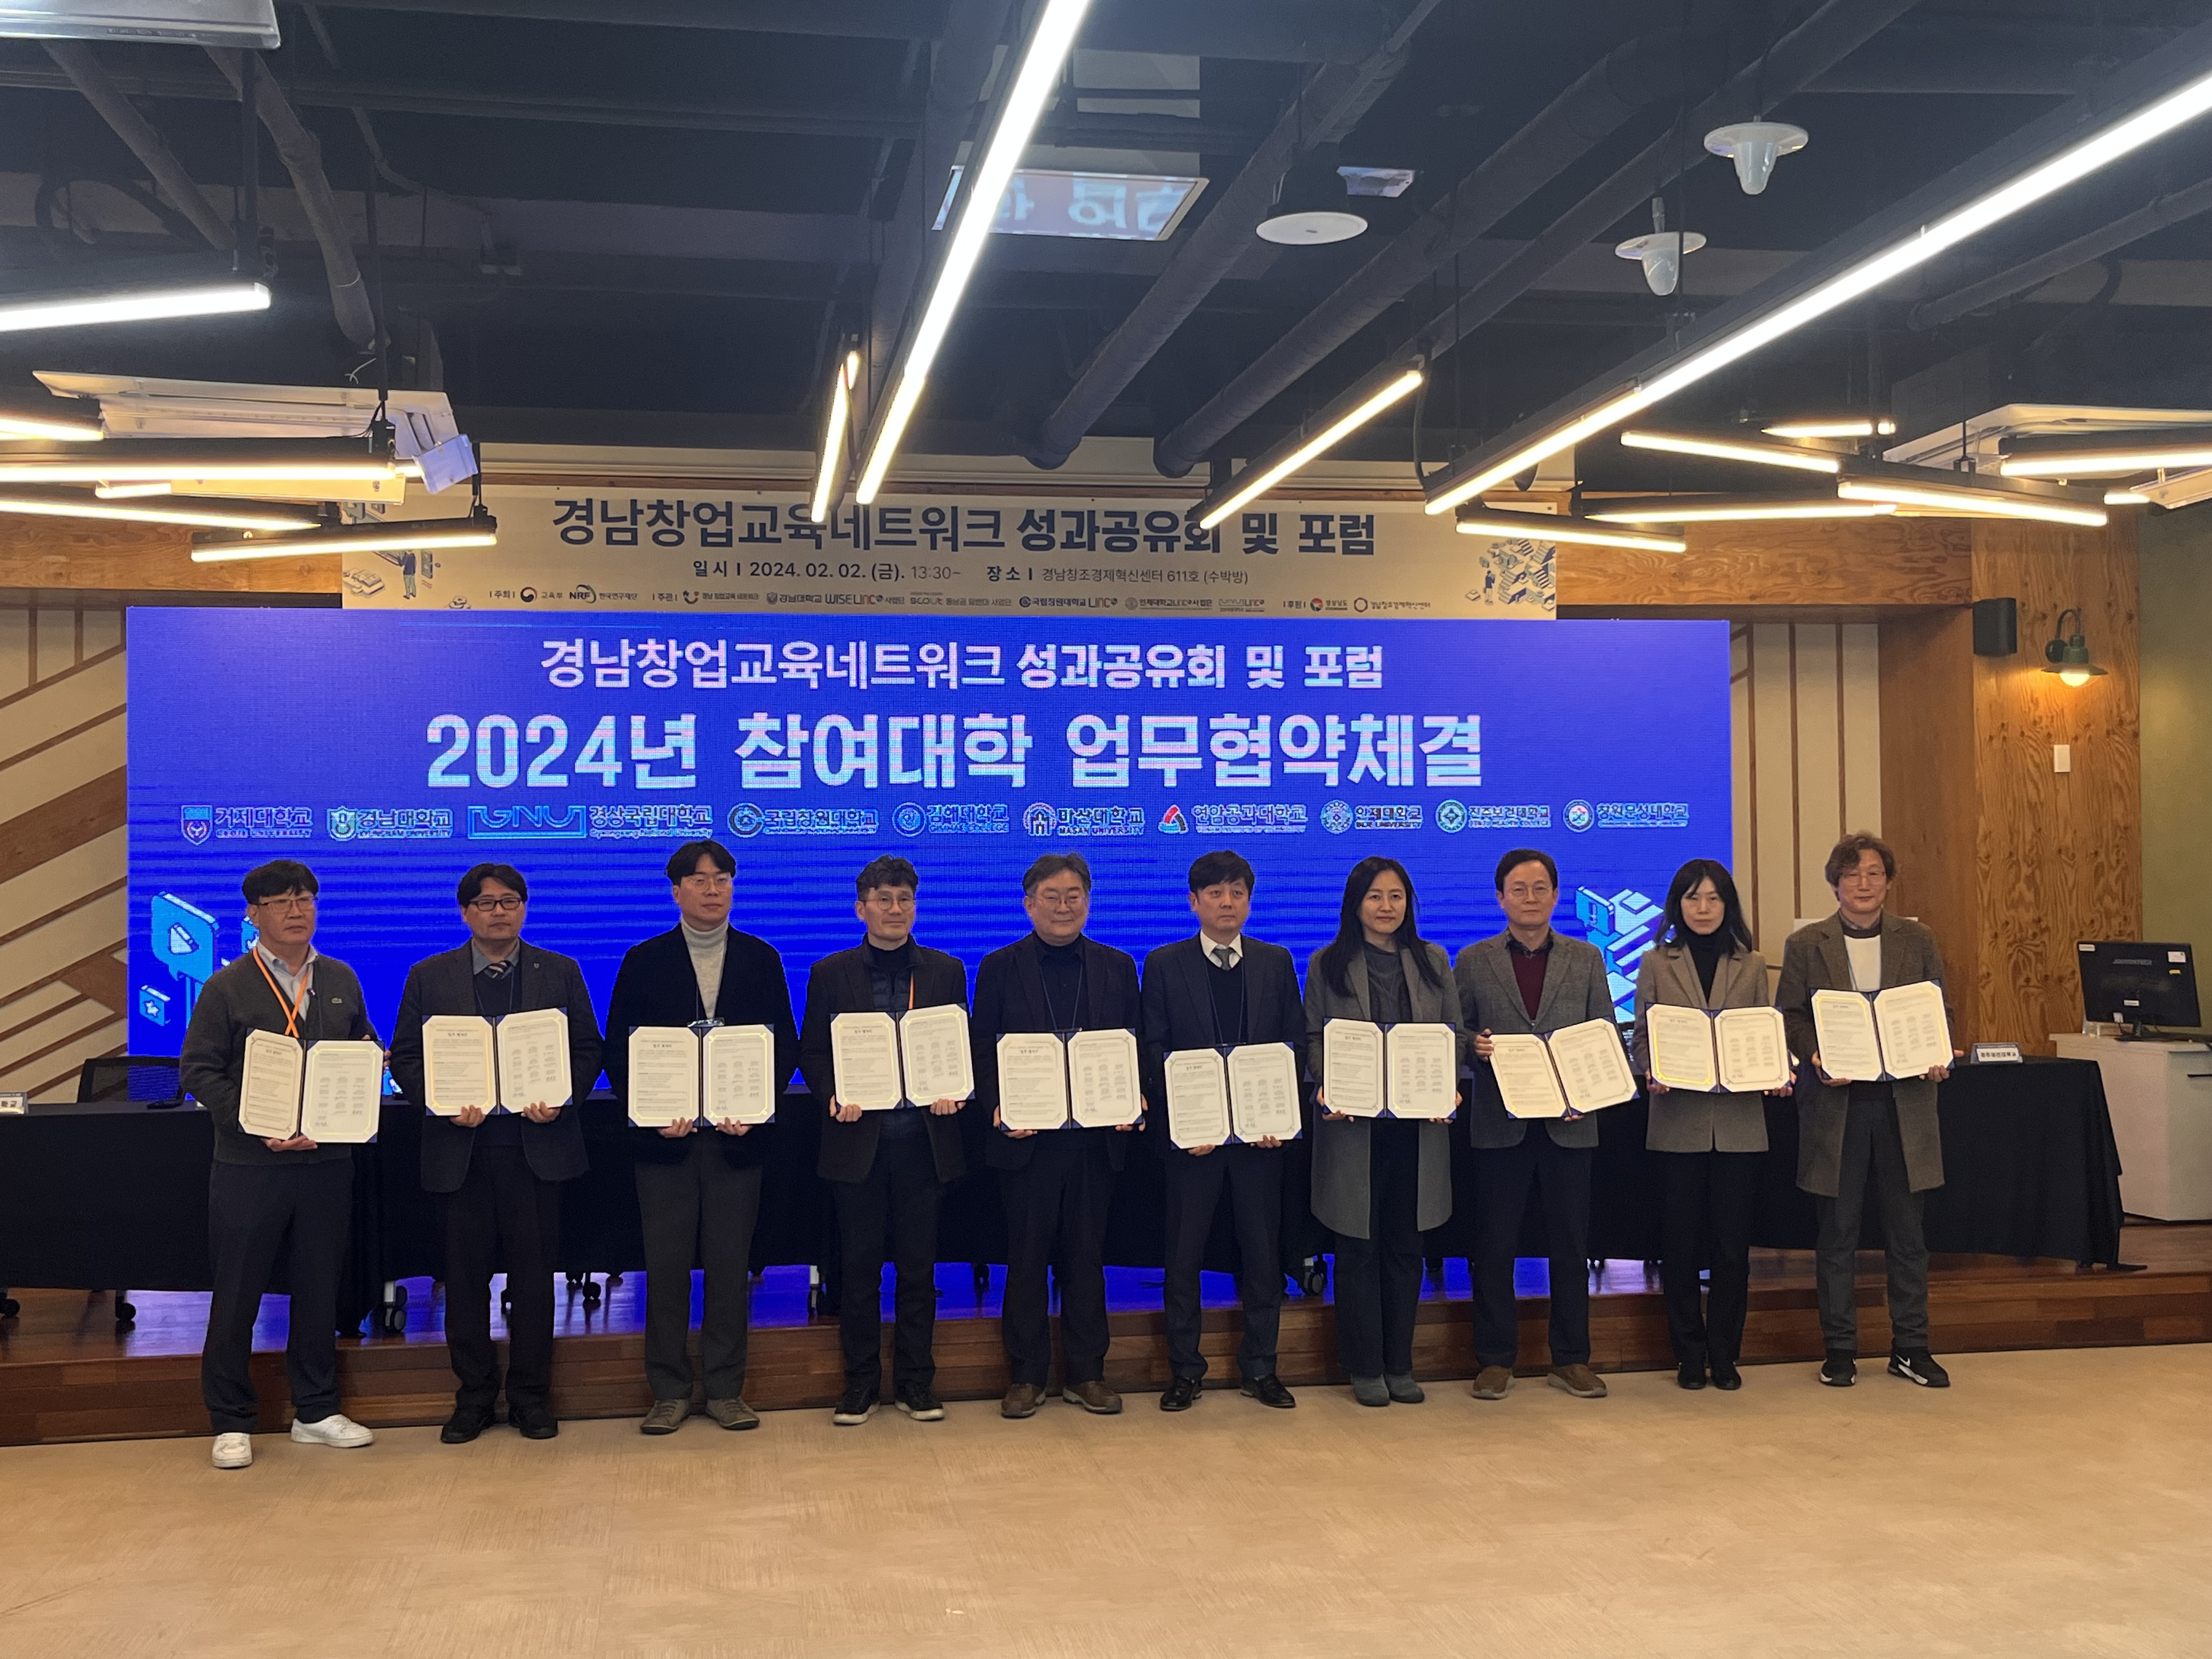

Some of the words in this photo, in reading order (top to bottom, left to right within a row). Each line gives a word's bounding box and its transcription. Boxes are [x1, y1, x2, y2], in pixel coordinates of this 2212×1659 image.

[553, 498, 1006, 552] 경남창업교육네트워크
[1017, 509, 1221, 554] 성과공유회
[1242, 512, 1279, 555] 및
[1299, 515, 1375, 555] 포럼
[749, 562, 800, 577] 2024.
[805, 563, 833, 578] 02.
[838, 563, 866, 578] 02.
[911, 566, 961, 580] 13:30~
[1167, 569, 1199, 583] 611호
[1204, 569, 1248, 585] (수박방)
[569, 591, 590, 600] NRF
[541, 638, 1005, 690] 경남창업교육네트워크
[1017, 644, 1225, 689] 성과공유회
[1246, 645, 1285, 689] 및
[1304, 645, 1383, 689] 포럼
[426, 713, 697, 788] 2024년
[735, 712, 1034, 788] 참여대학
[1066, 713, 1482, 787] 업무협약체결
[215, 806, 314, 827] 거제대학교
[358, 809, 453, 828] 경남대학교
[589, 805, 714, 827] 경상국립대학교
[764, 809, 879, 828] 국립창원대학교
[927, 804, 1009, 823] 김해대학교
[1057, 806, 1144, 825] 마산대학교
[1192, 804, 1308, 825] 연암공과대학교
[1356, 805, 1423, 821] 인제대학교
